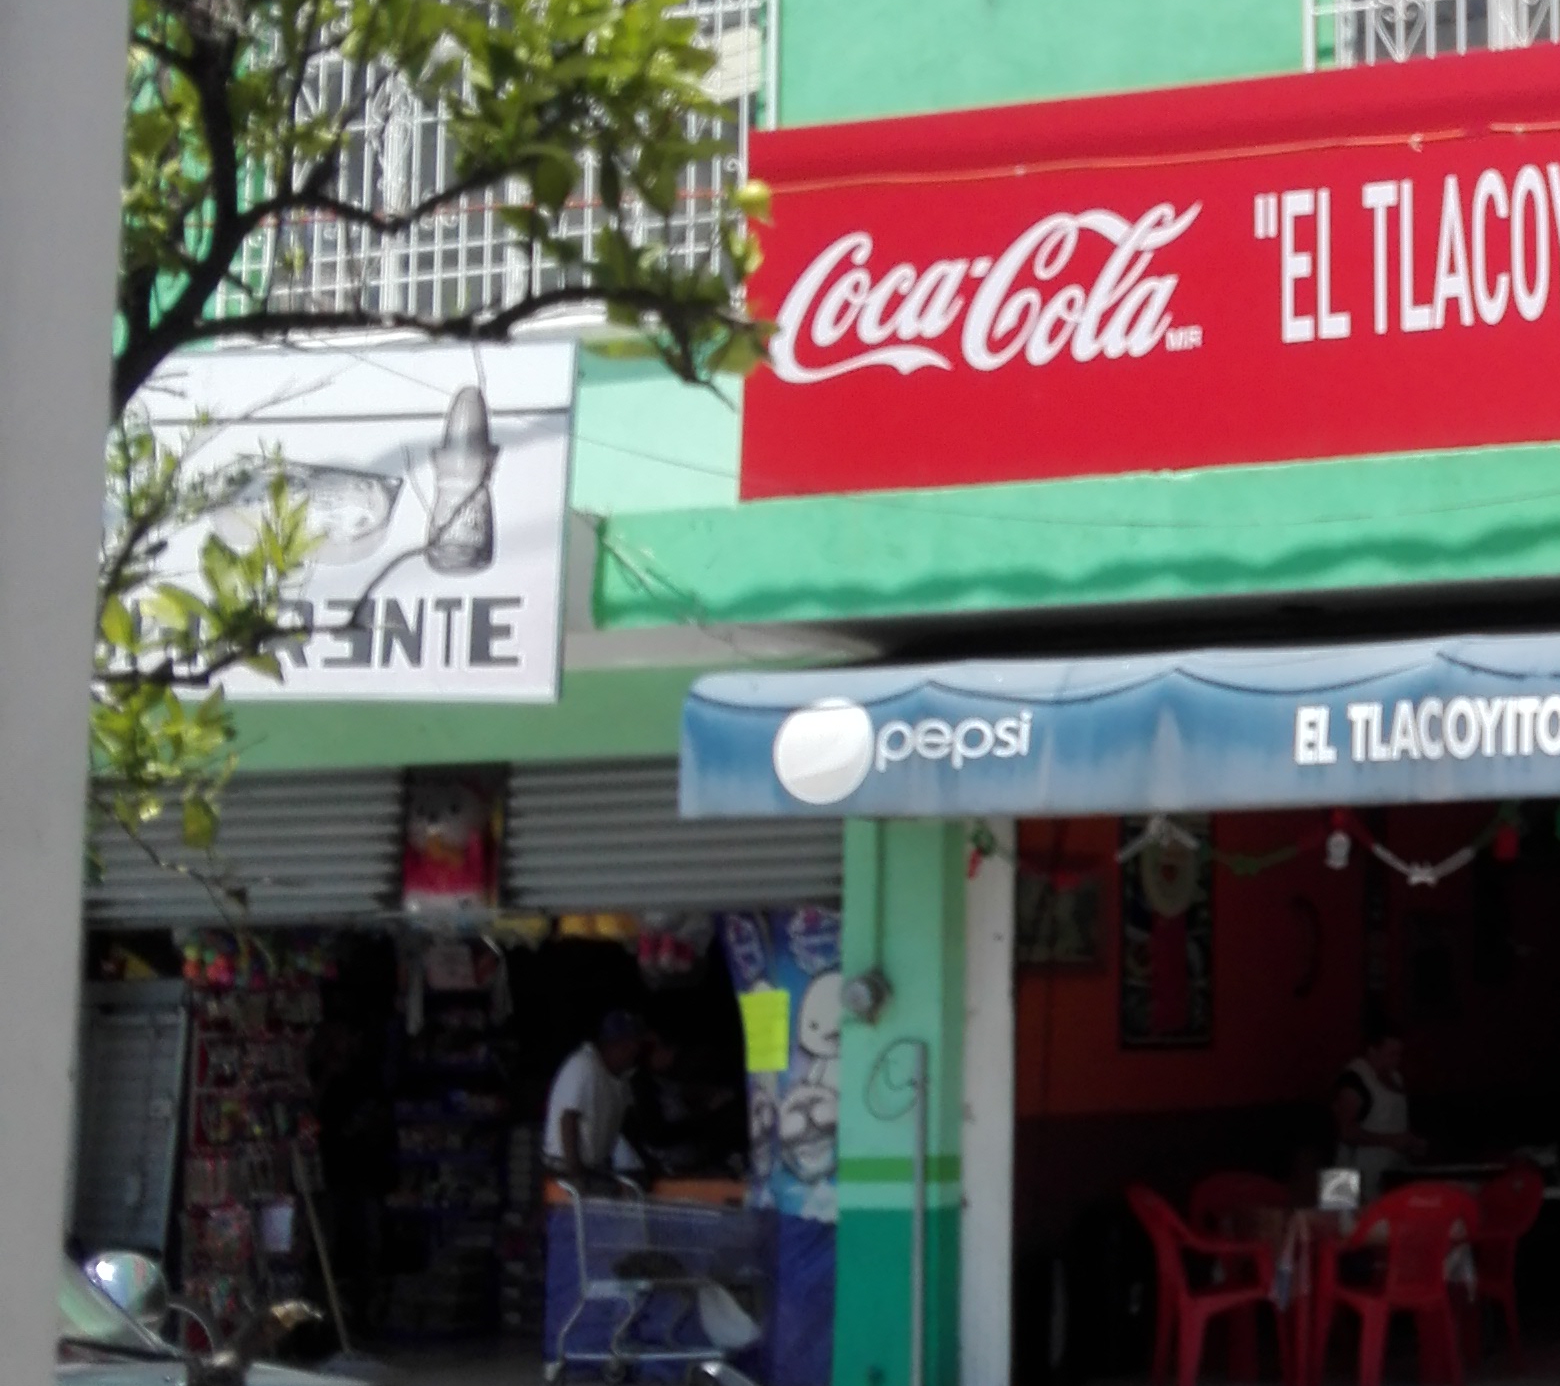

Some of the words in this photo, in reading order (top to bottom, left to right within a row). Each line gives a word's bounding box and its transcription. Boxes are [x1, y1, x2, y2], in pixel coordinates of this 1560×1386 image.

[767, 202, 1203, 384] Coca-Cola
[1164, 325, 1203, 352] MR
[873, 710, 1033, 773] pepsi
[1294, 705, 1336, 765] EL
